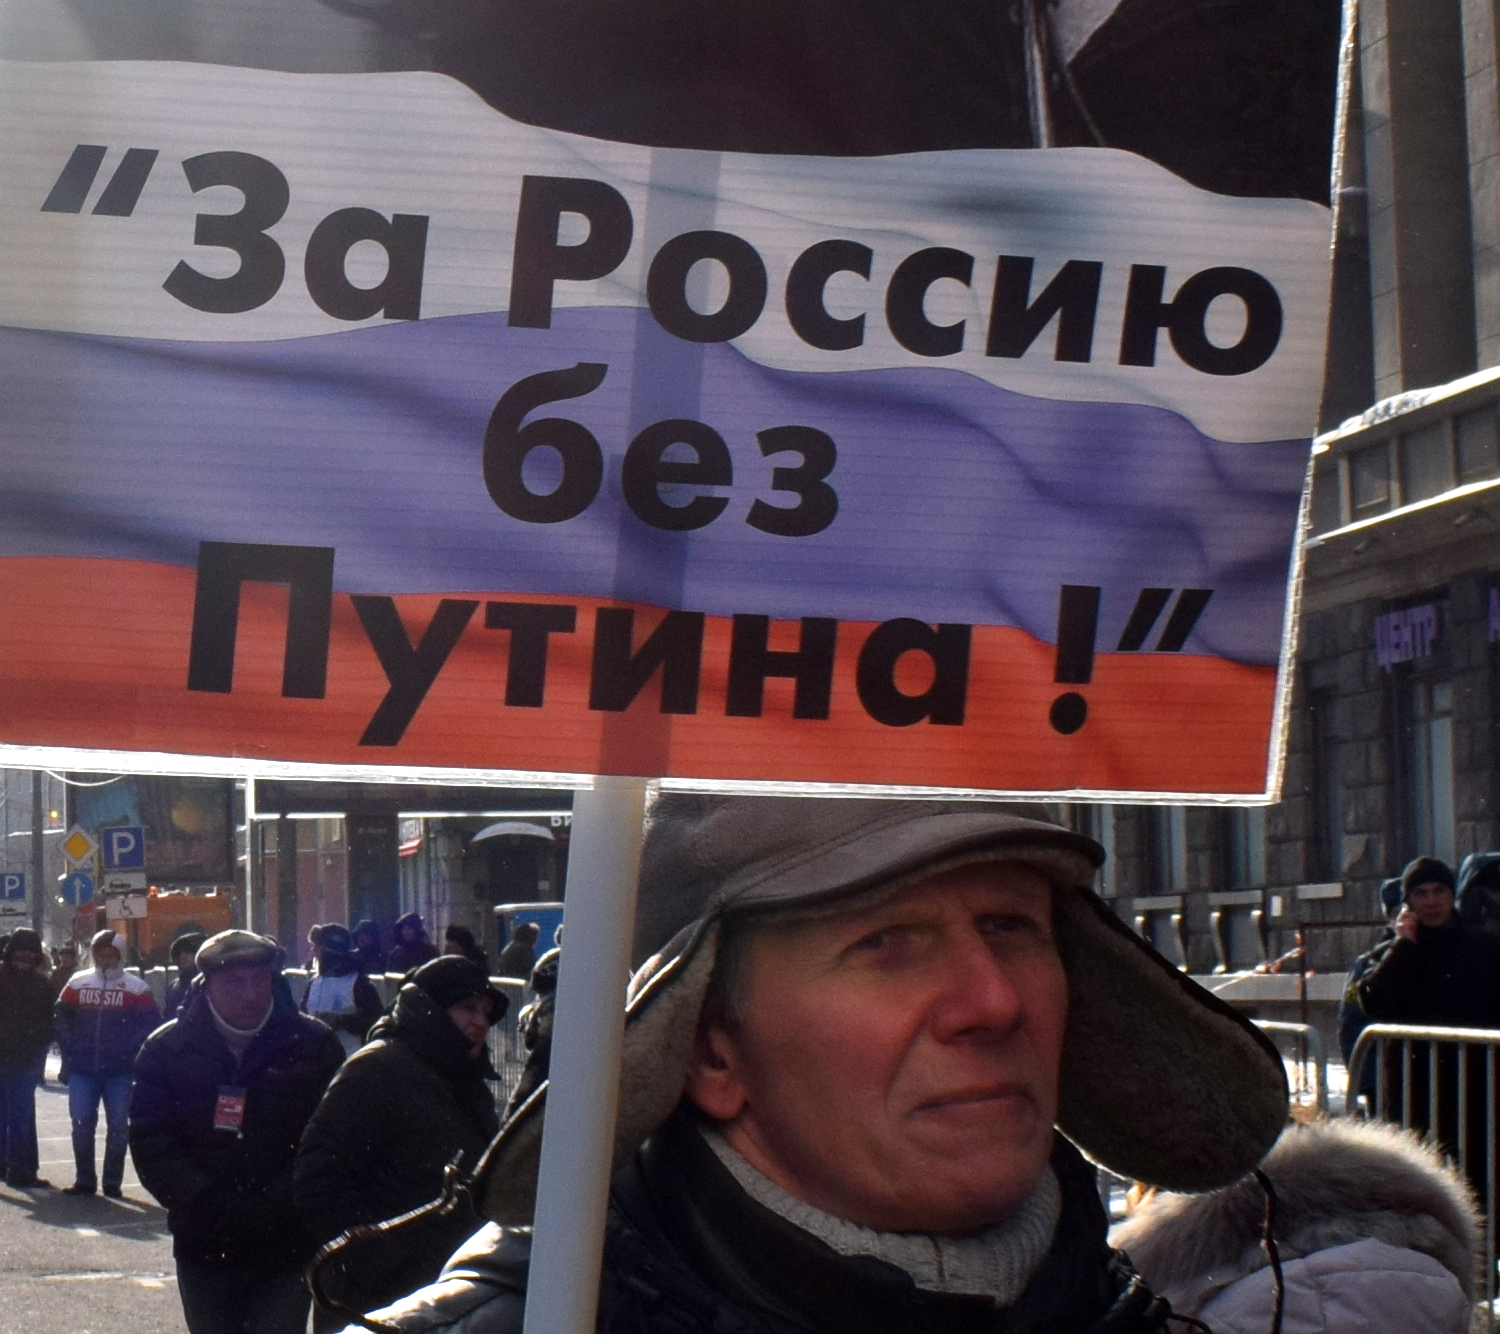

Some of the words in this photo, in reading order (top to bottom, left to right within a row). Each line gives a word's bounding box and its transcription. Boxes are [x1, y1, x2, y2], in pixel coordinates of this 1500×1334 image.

[507, 174, 1285, 377] Россию
[482, 362, 839, 538] без
[1374, 603, 1440, 673] ЦЕНТР
[112, 831, 136, 865] P
[4, 875, 20, 897] P
